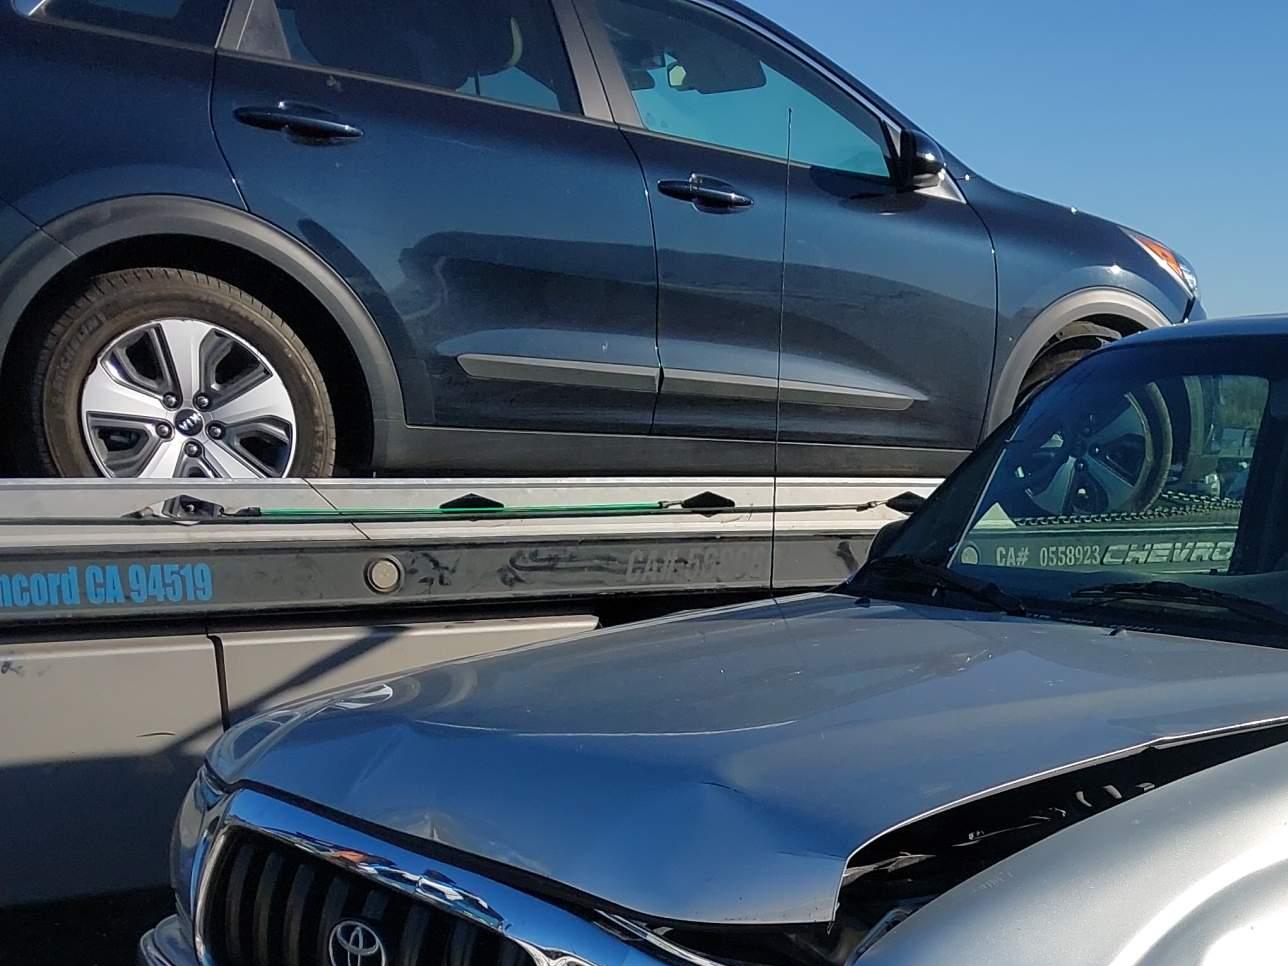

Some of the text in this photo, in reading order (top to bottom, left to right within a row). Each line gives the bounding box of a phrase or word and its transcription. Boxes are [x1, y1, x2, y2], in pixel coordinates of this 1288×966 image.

[996, 545, 1101, 567] CA# 0558923
[85, 565, 126, 605] CA
[129, 563, 214, 602] 94519
